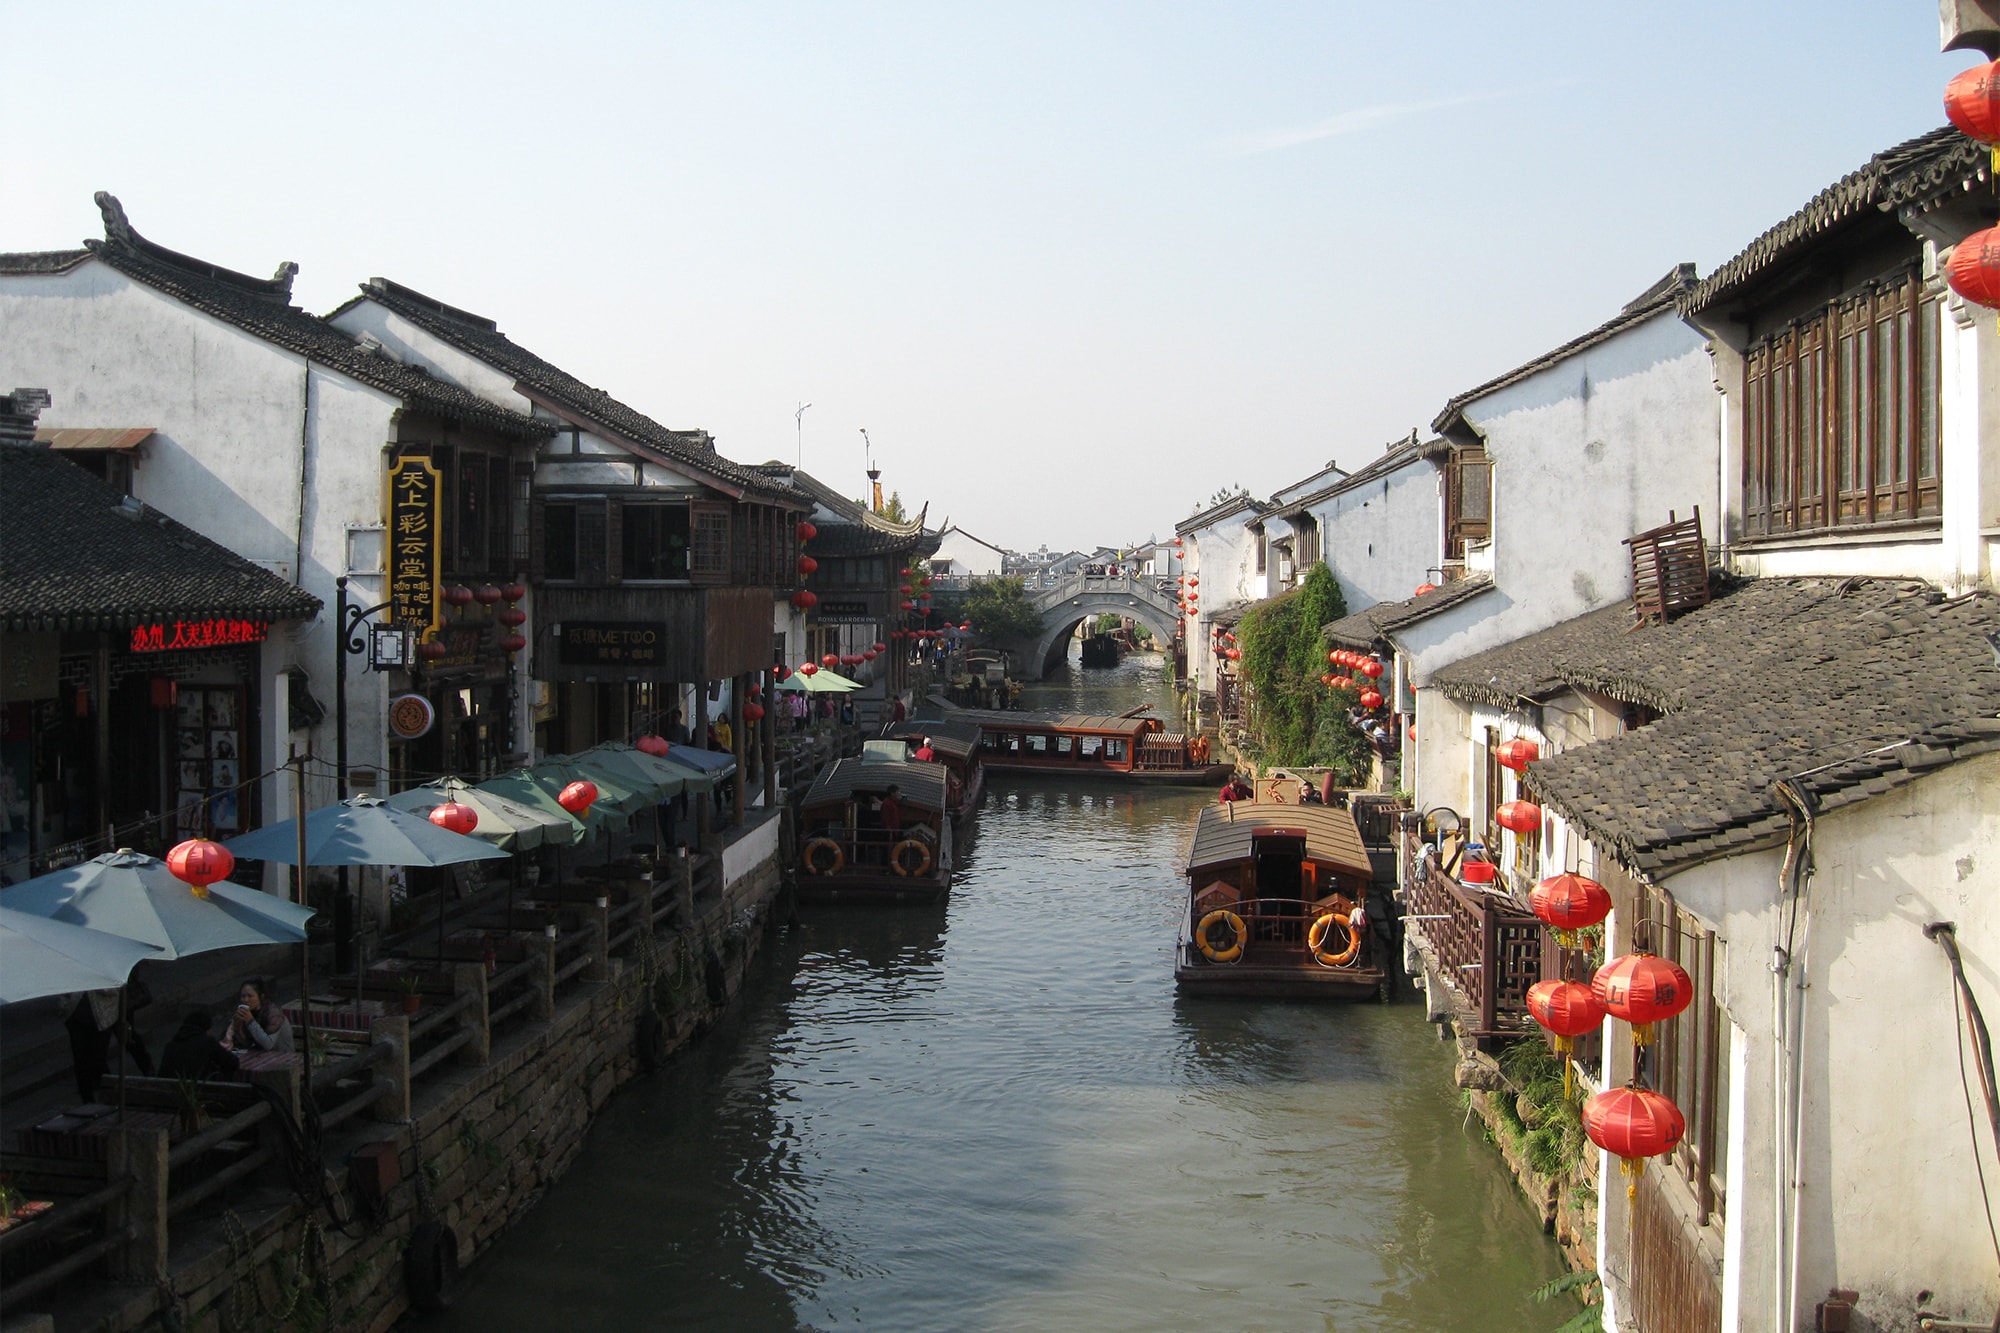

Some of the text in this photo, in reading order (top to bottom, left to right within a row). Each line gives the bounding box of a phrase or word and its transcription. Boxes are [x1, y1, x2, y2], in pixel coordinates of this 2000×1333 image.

[397, 471, 428, 579] 天上彩云堂
[393, 580, 431, 592] 咖啡
[401, 606, 423, 616] Bar
[133, 623, 165, 649] 苏州
[195, 861, 213, 876] 山
